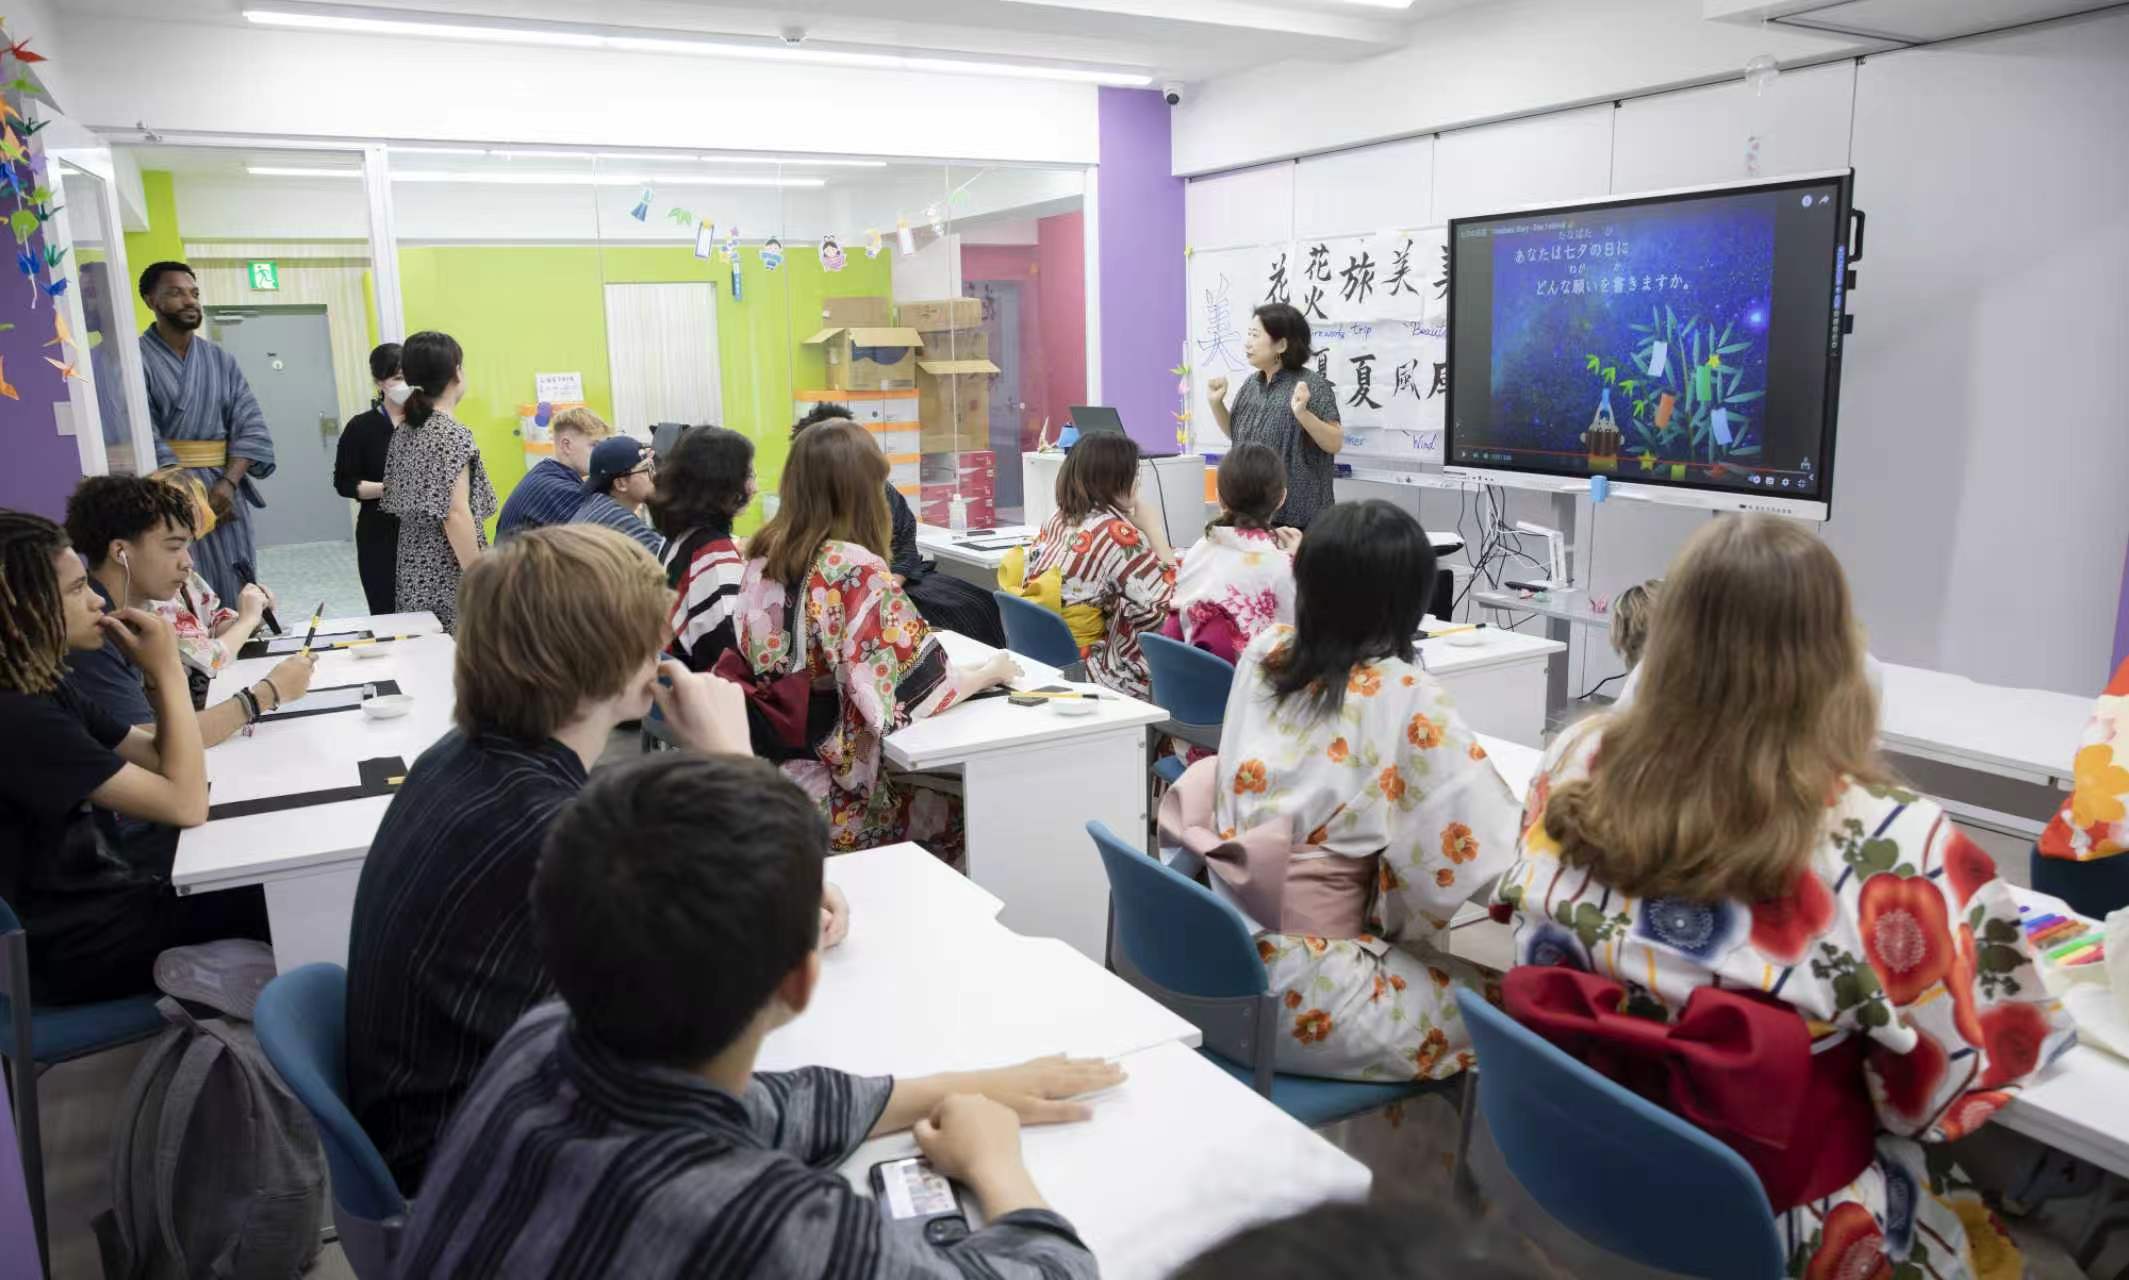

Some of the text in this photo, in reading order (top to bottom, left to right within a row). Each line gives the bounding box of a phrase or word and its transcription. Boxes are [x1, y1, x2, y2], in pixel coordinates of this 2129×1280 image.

[1383, 239, 1420, 297] 美
[1514, 240, 1629, 264] あなたは七夕の日に
[1339, 252, 1376, 304] 旅
[1536, 273, 1690, 296] どんな願いを書きますか。
[1346, 353, 1383, 409] 夏
[1393, 359, 1421, 400] 風
[1412, 431, 1439, 449] Wind
